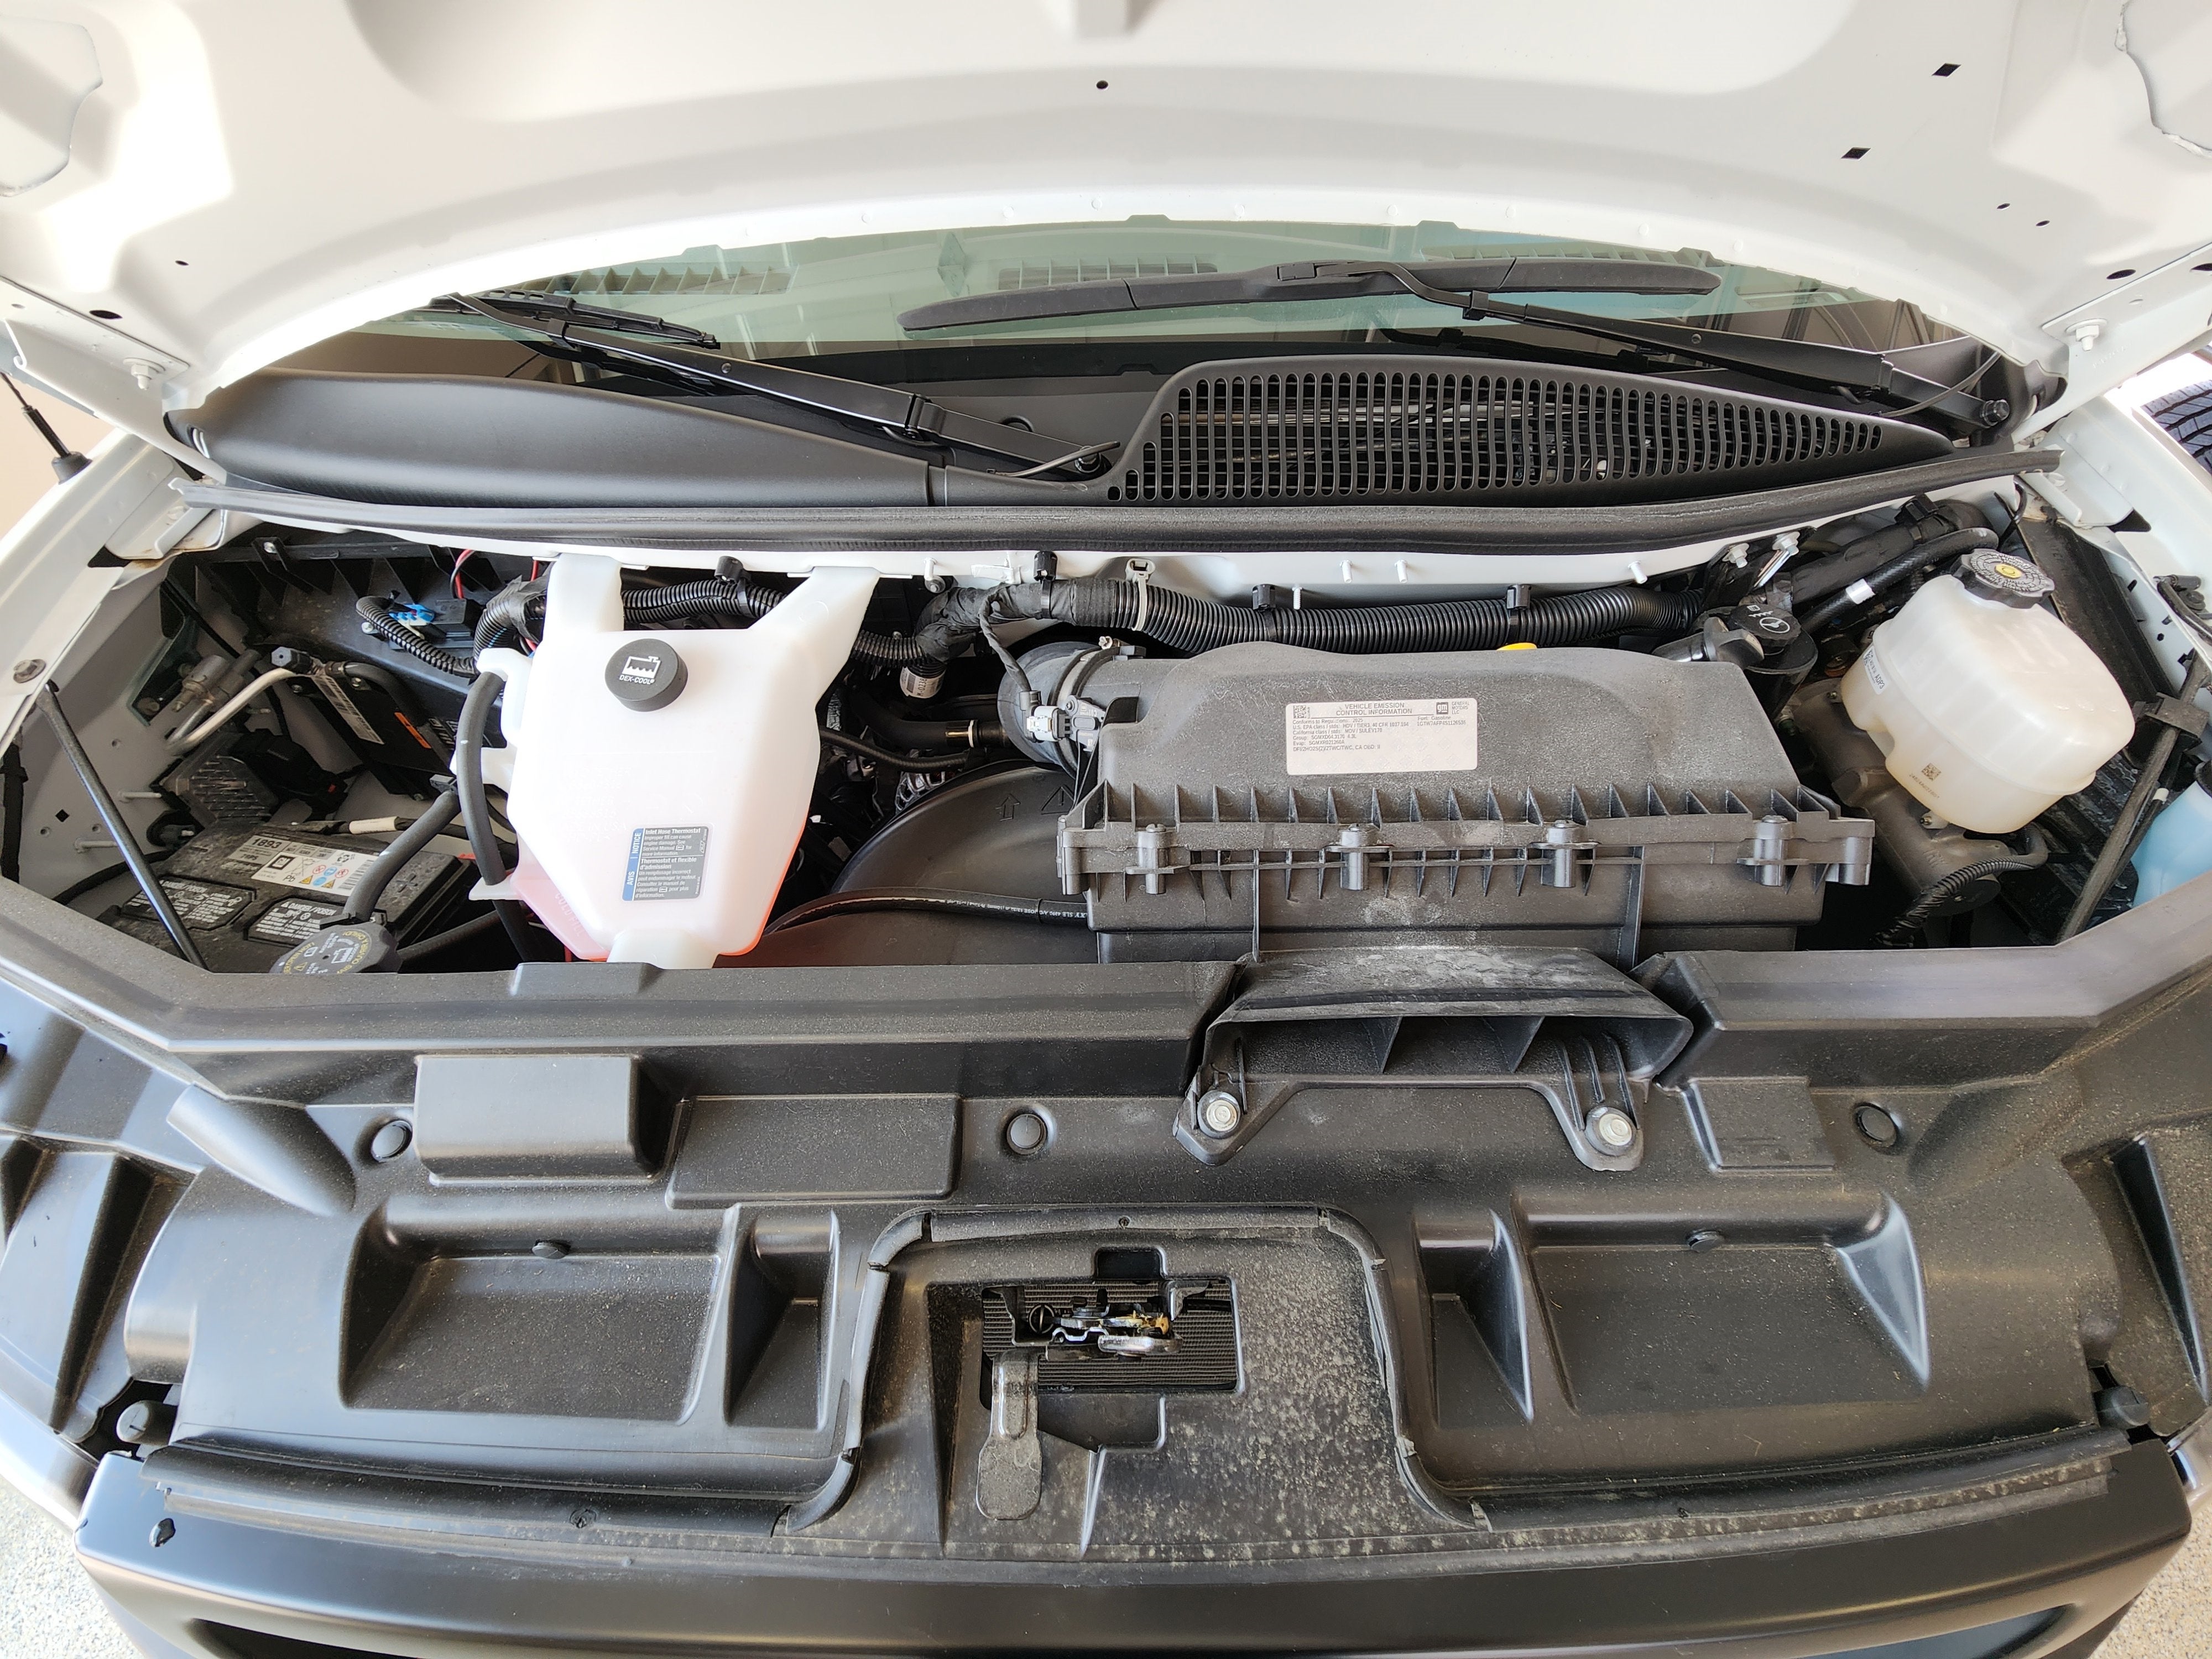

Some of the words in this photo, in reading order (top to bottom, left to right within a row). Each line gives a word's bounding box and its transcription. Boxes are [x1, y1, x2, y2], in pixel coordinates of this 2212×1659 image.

[1874, 674, 1885, 689] ADP3
[1437, 704, 1448, 713] gm
[252, 838, 282, 849] 1893
[632, 833, 641, 854] NOTICE
